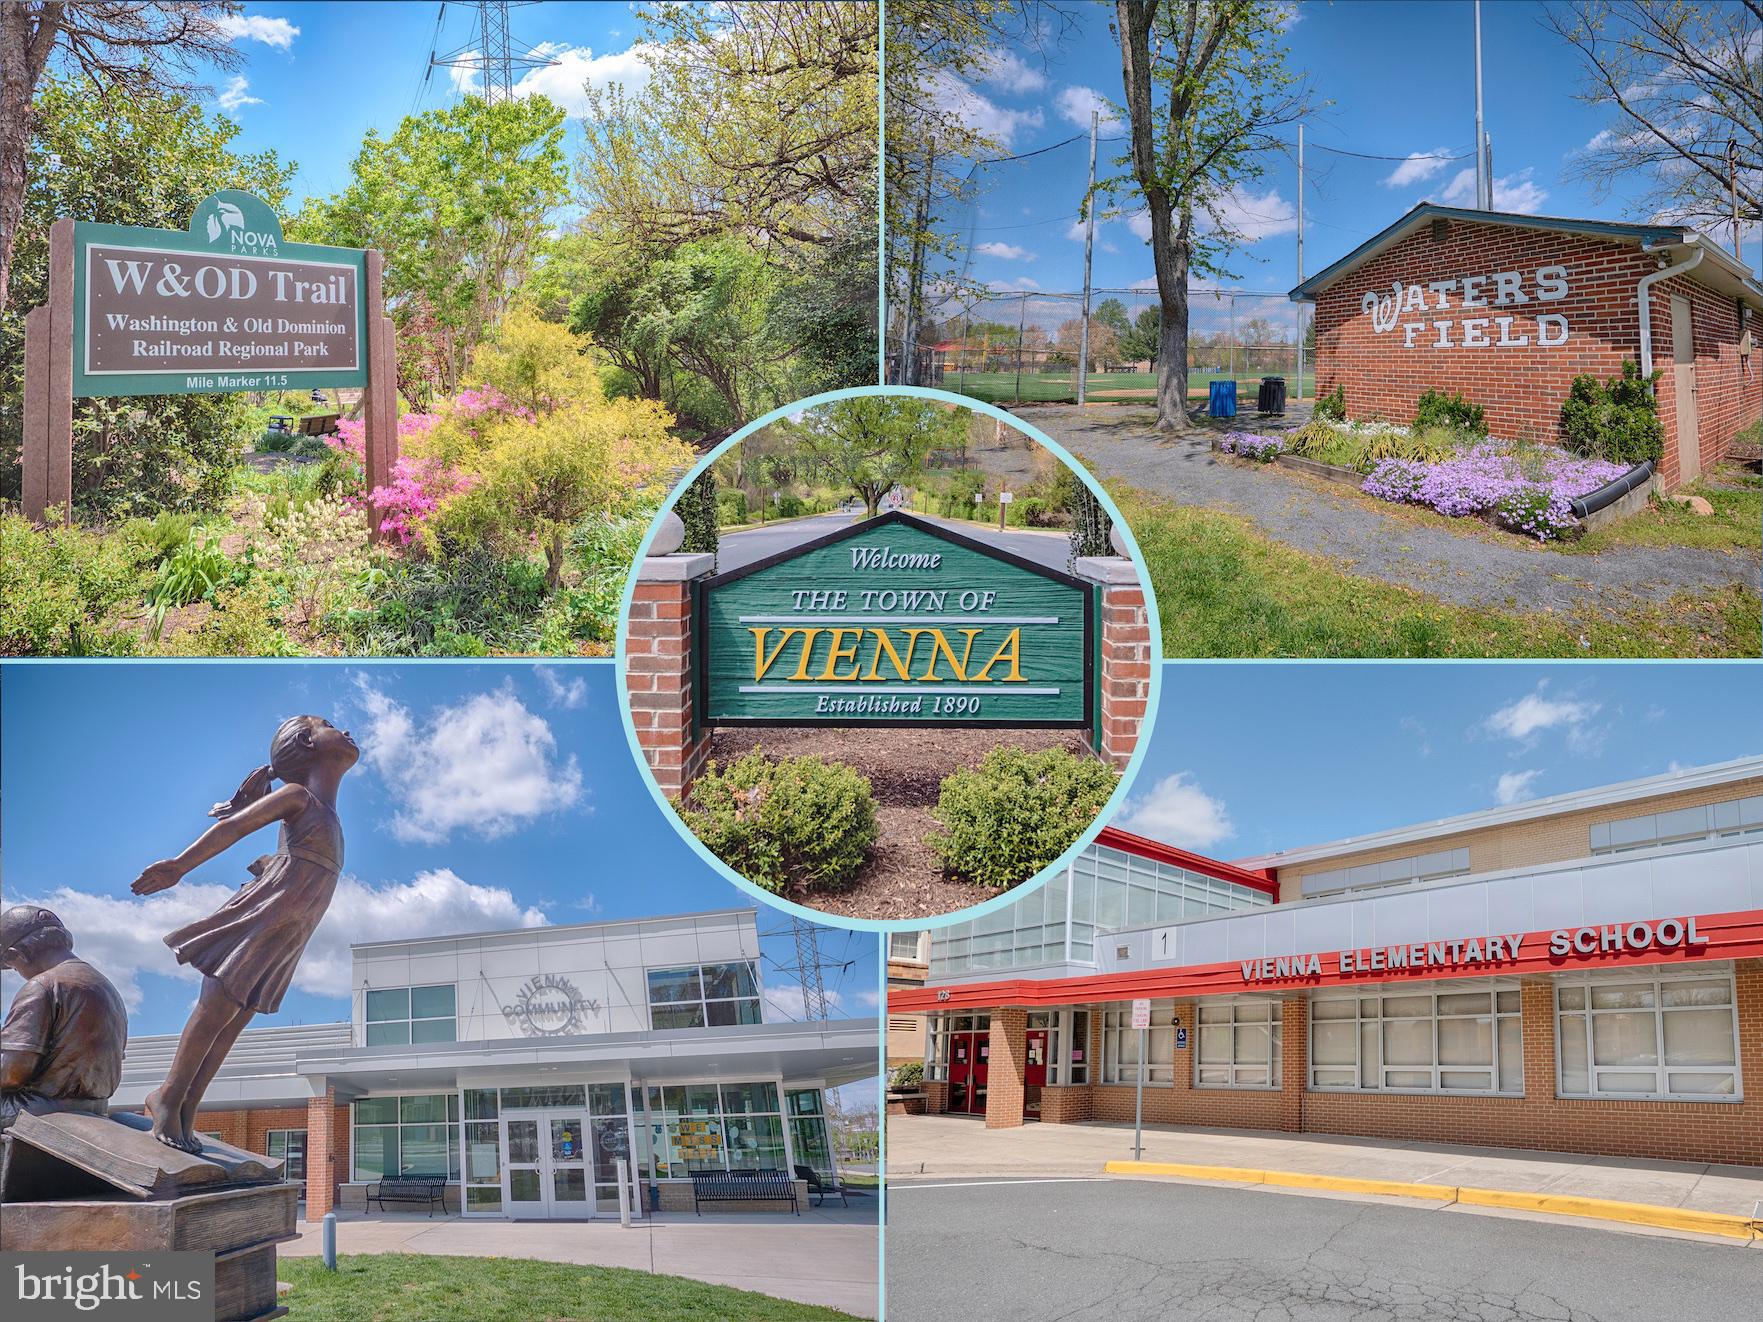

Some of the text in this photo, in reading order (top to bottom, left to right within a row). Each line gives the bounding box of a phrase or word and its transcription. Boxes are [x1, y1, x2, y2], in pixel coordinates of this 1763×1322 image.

[231, 229, 277, 248] NOVA
[231, 244, 279, 256] PARKS
[105, 258, 347, 305] W&OD Trail
[1362, 265, 1569, 334] WATERS
[106, 313, 346, 336] Washington & Old Dominion
[1403, 313, 1570, 349] FIELD
[132, 340, 329, 359] Railroad Regional Park
[186, 375, 288, 388] Mile Marker 11.5
[849, 548, 942, 571] Welcome
[791, 590, 997, 611] THE TOWN OF
[748, 628, 1028, 683] VIENNA
[815, 696, 980, 714] Established 1890
[1161, 932, 1168, 955] 1
[1241, 917, 1710, 981] VIENNA ELEMENTARY SCHOOL
